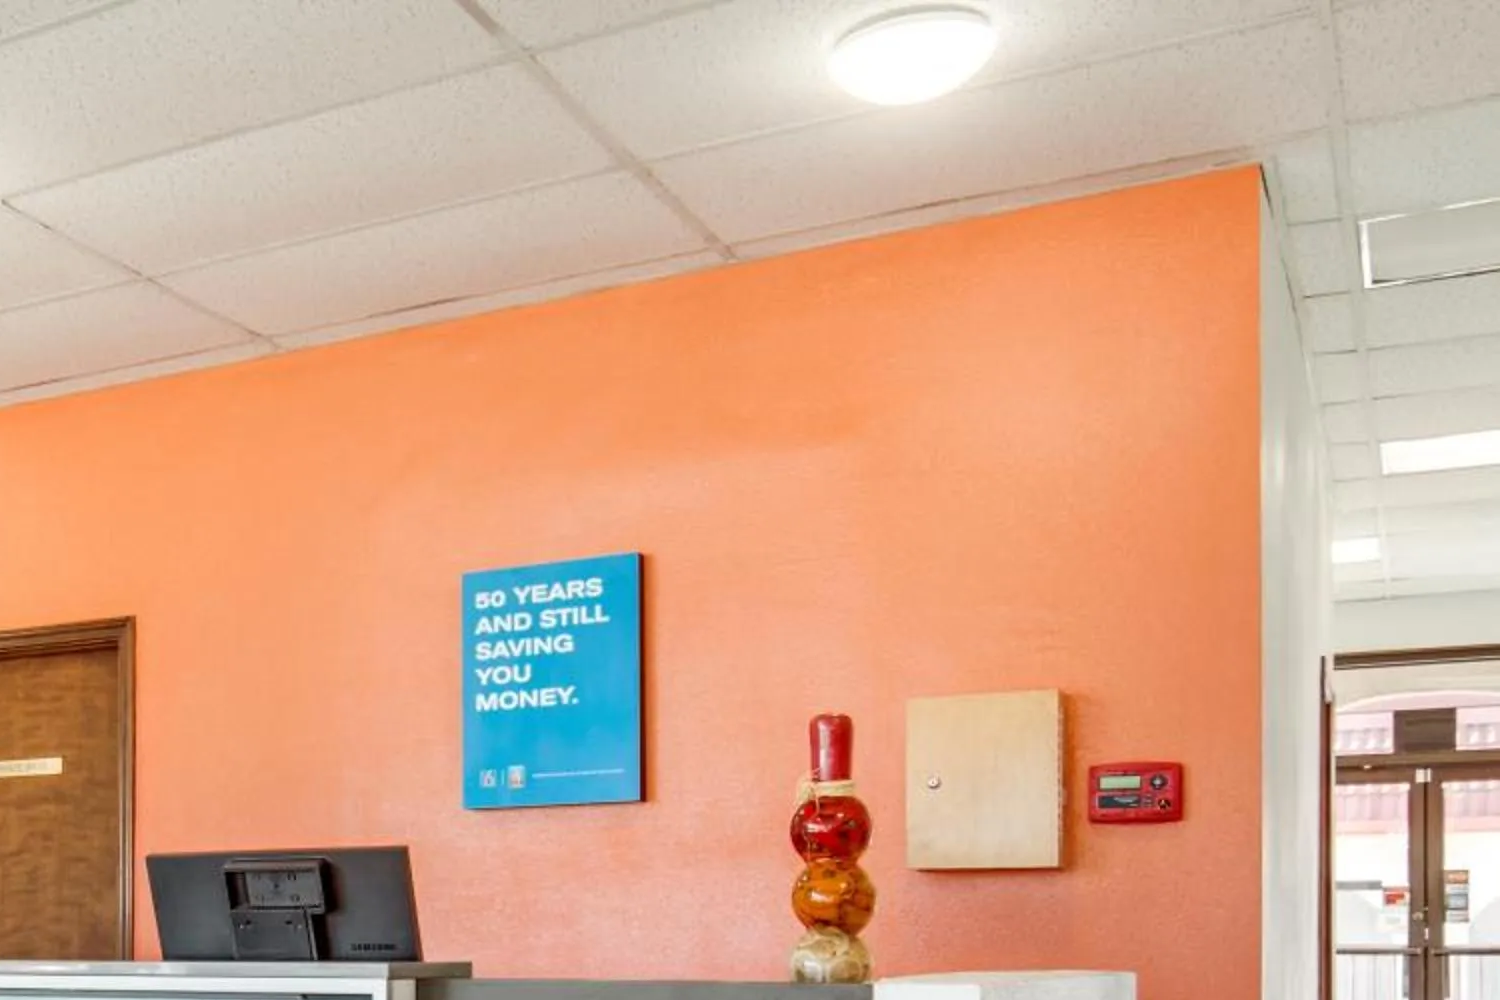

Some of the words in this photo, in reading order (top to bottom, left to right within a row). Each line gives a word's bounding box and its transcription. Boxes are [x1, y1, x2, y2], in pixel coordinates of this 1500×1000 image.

[475, 591, 506, 608] 50
[514, 578, 603, 604] YEARS
[475, 612, 532, 634] AND
[540, 605, 610, 628] STILL
[475, 633, 574, 660] SAVING
[475, 664, 531, 685] YOU
[475, 686, 579, 711] MONEY.
